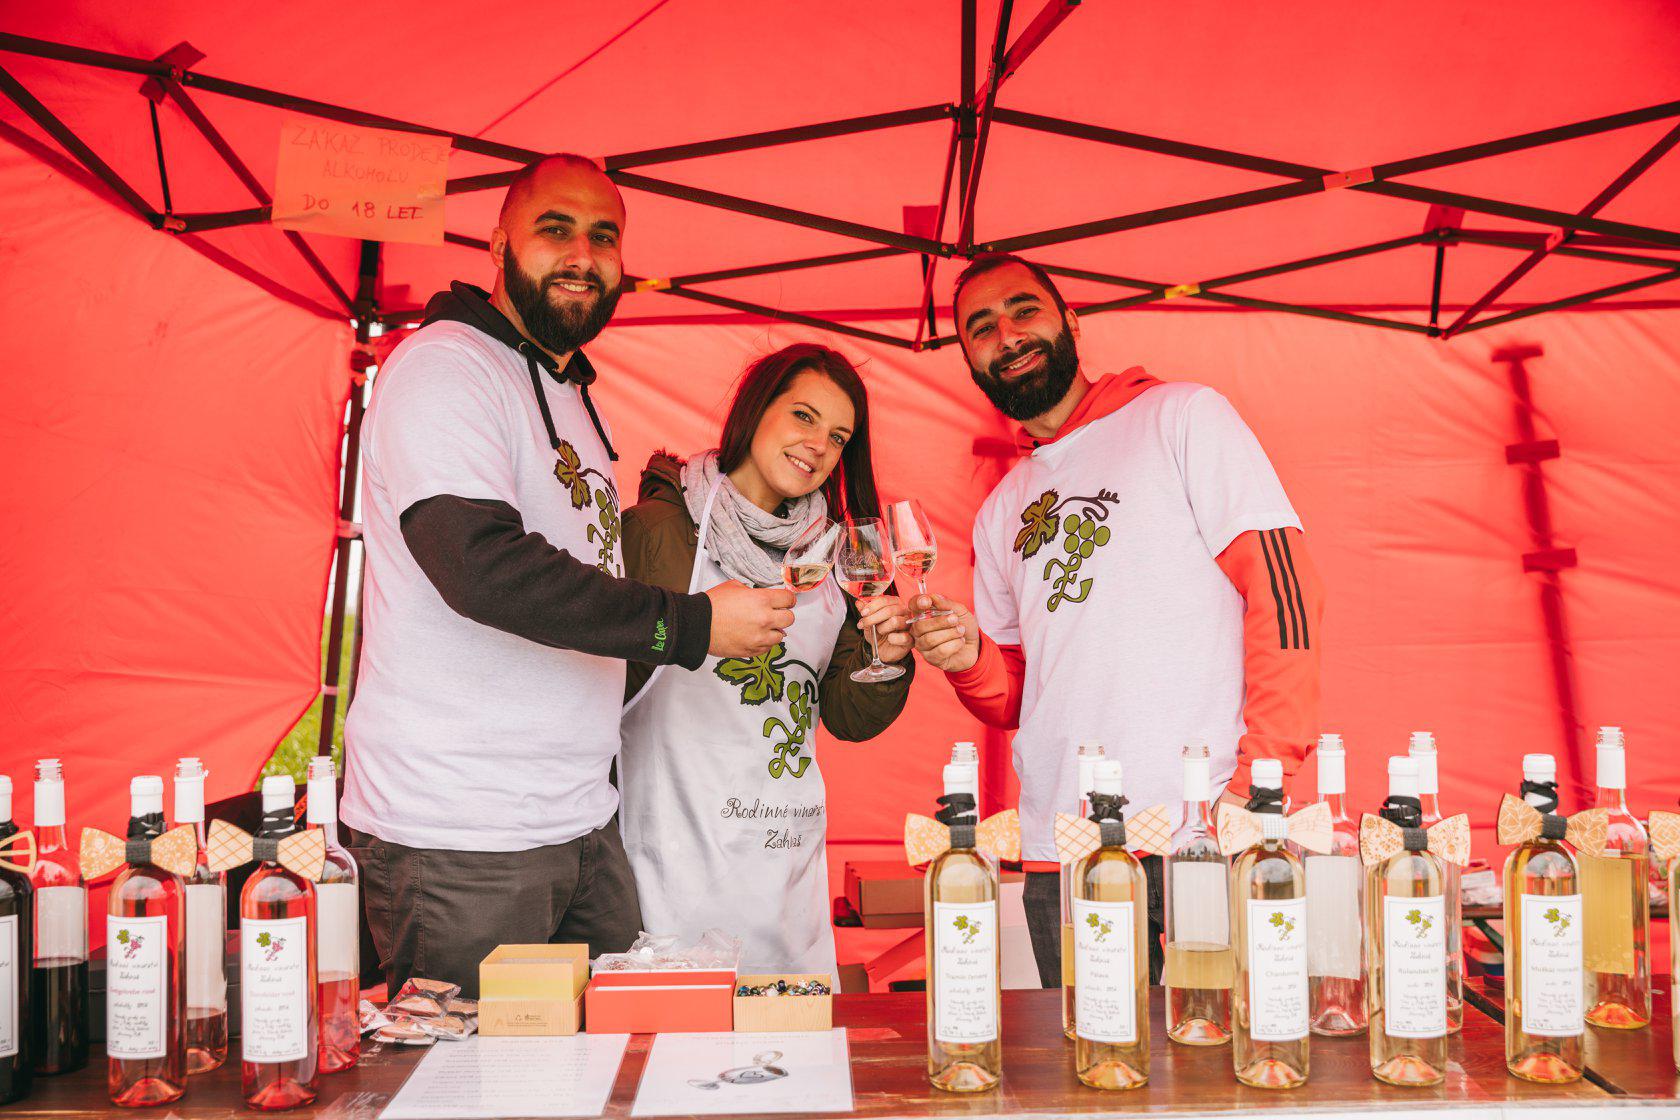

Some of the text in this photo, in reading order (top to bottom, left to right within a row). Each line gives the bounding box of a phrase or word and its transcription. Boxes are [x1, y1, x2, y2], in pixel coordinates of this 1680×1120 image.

[303, 194, 424, 220] DO 18 LET
[720, 797, 789, 819] Rodinné
